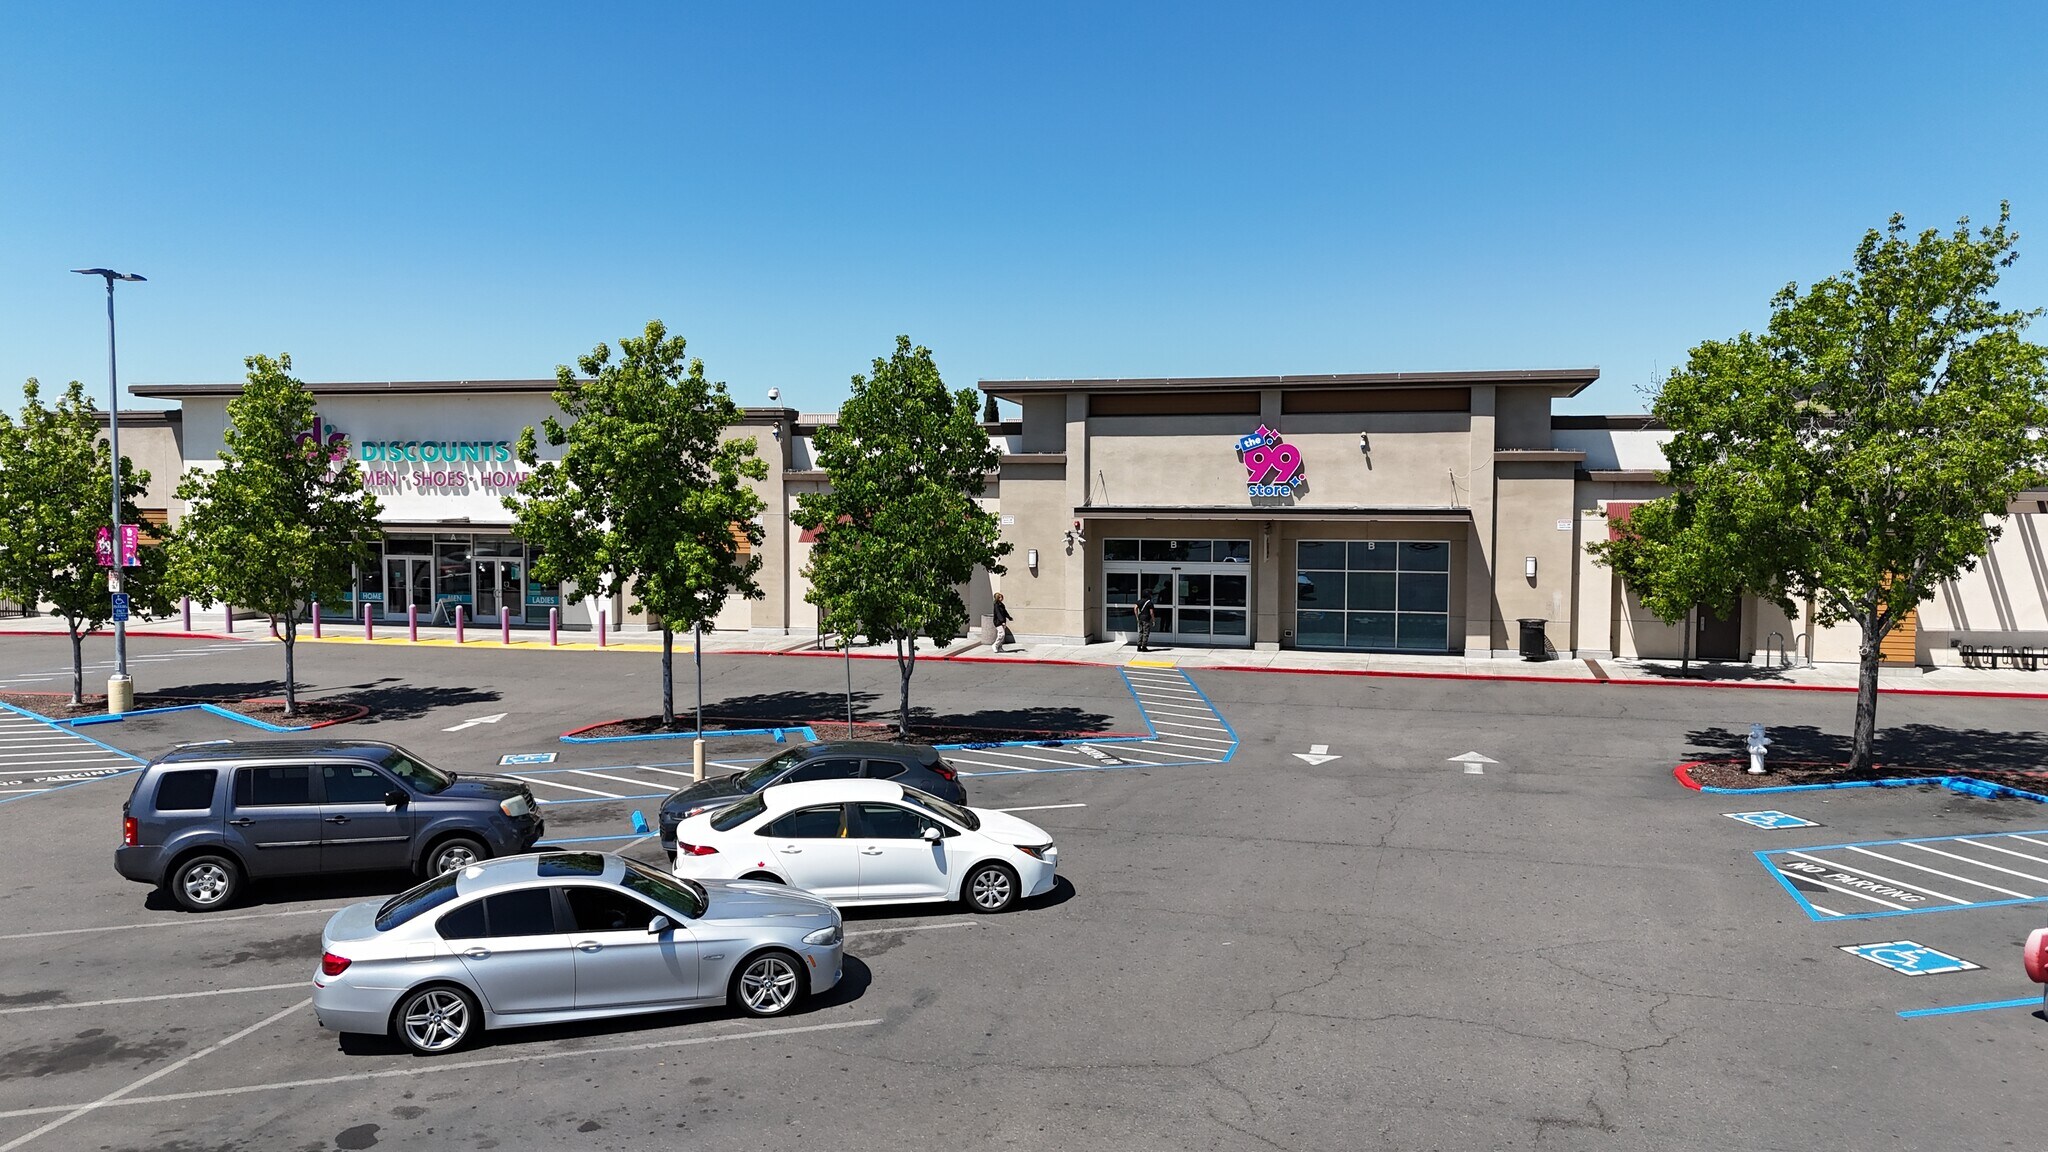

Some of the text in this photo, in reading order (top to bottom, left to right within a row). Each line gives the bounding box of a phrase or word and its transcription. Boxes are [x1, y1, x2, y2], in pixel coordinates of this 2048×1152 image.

[1243, 437, 1261, 448] the
[361, 441, 509, 462] DISCOUNTS
[1243, 443, 1302, 484] 99
[362, 471, 397, 486] MEN
[412, 470, 465, 487] SHOES
[1248, 484, 1290, 497] store
[450, 533, 457, 541] A
[1170, 540, 1177, 549] B
[1368, 542, 1376, 550] B
[362, 592, 382, 600] HOME
[532, 596, 555, 604] LADIES
[33, 769, 120, 782] PARKING
[1786, 862, 1927, 902] NO PARKING
